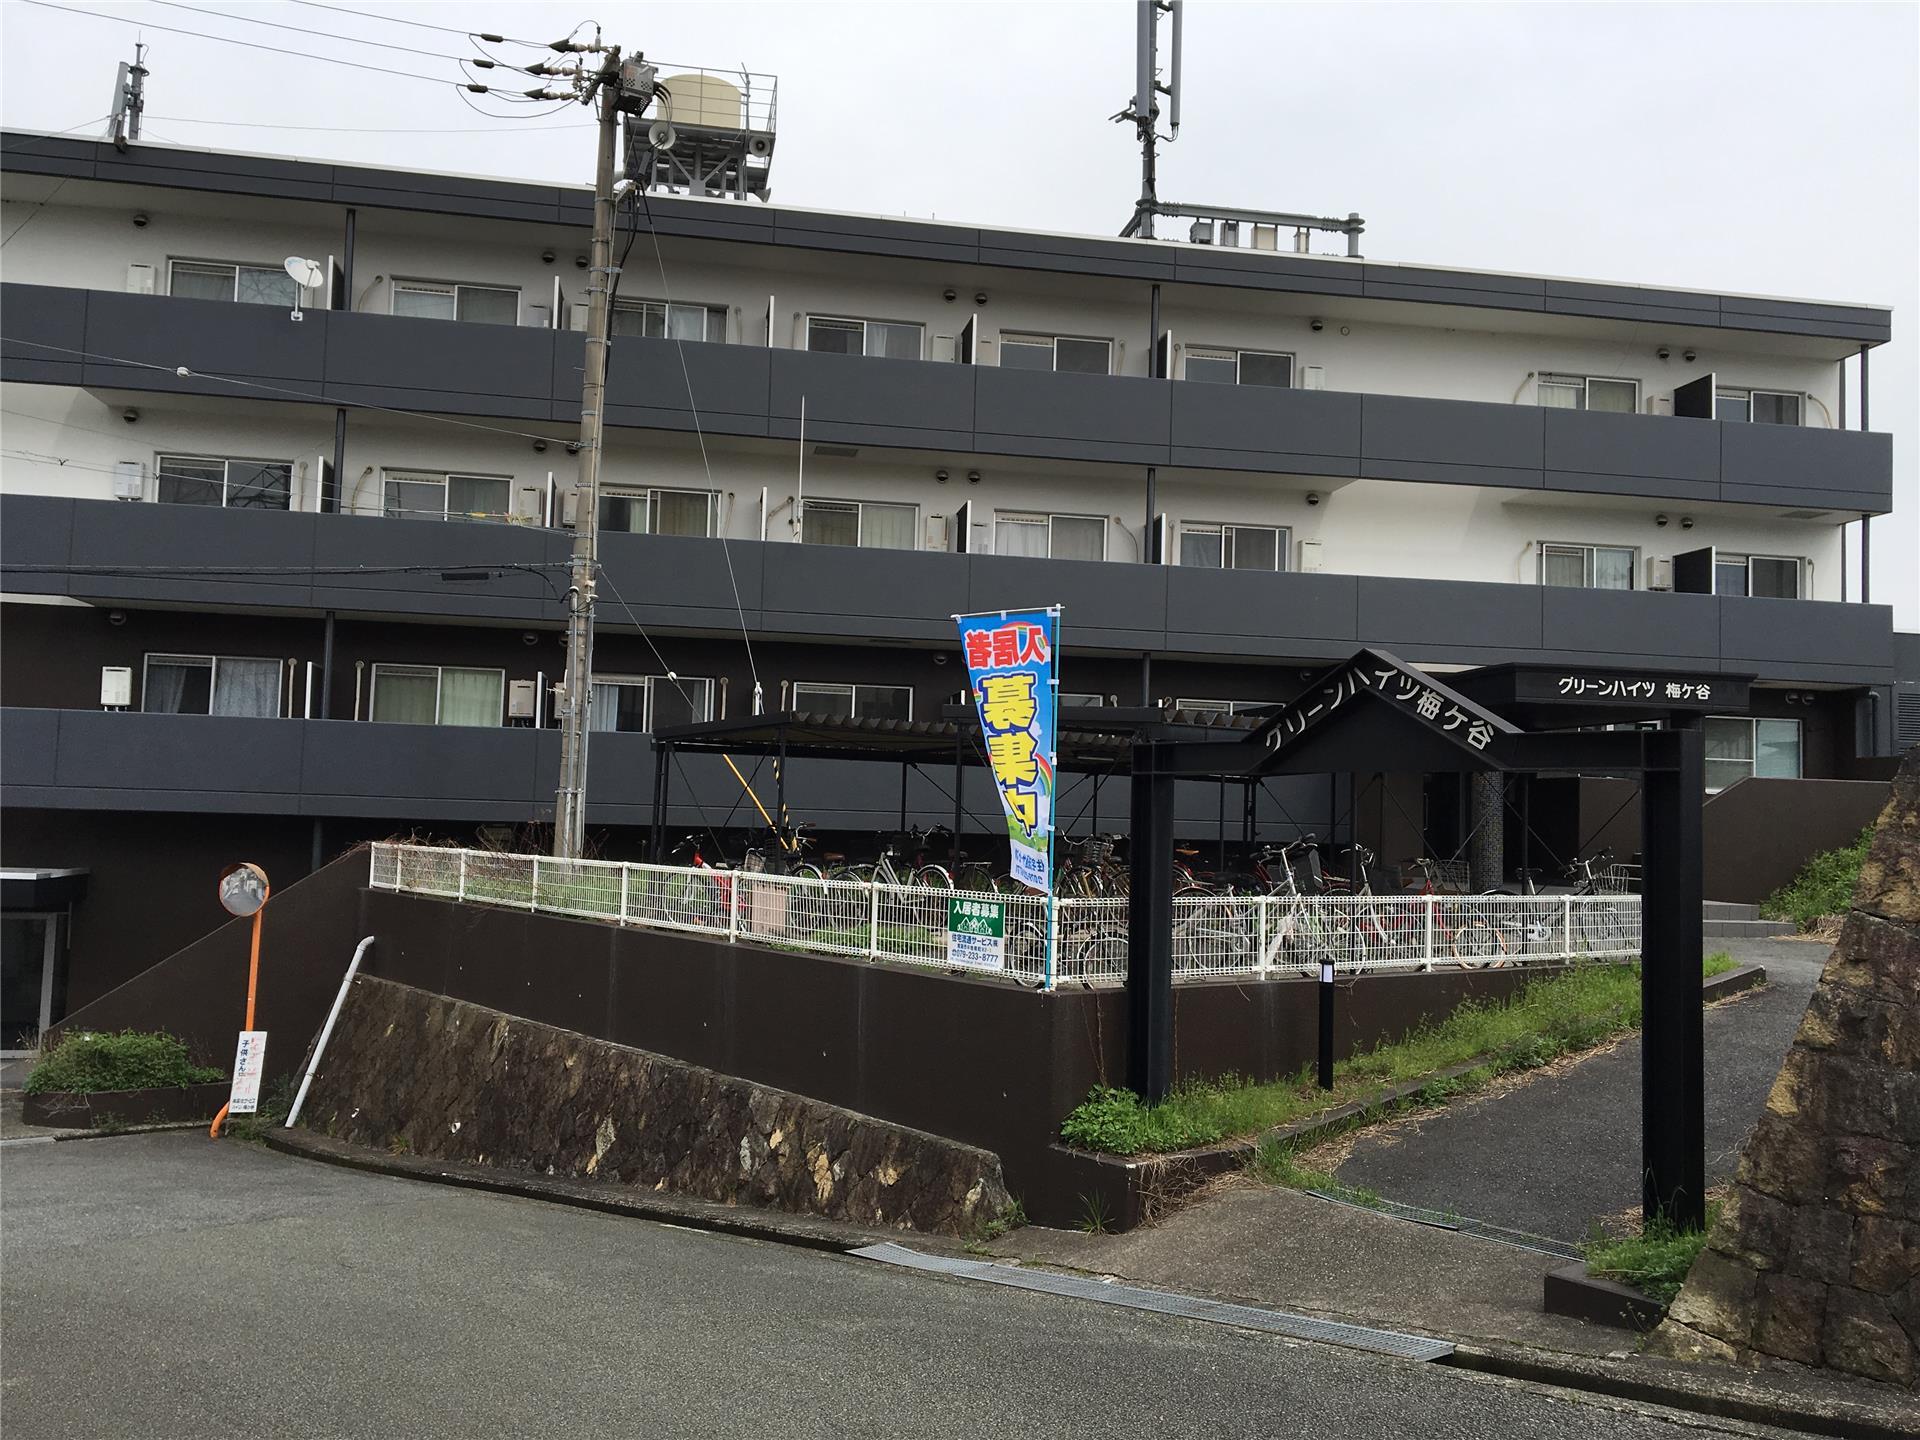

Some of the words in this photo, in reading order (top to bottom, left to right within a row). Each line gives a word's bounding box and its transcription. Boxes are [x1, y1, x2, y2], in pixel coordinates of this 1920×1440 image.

[1558, 676, 1655, 698] グリーンハイツ
[953, 900, 999, 919] 入居者募集
